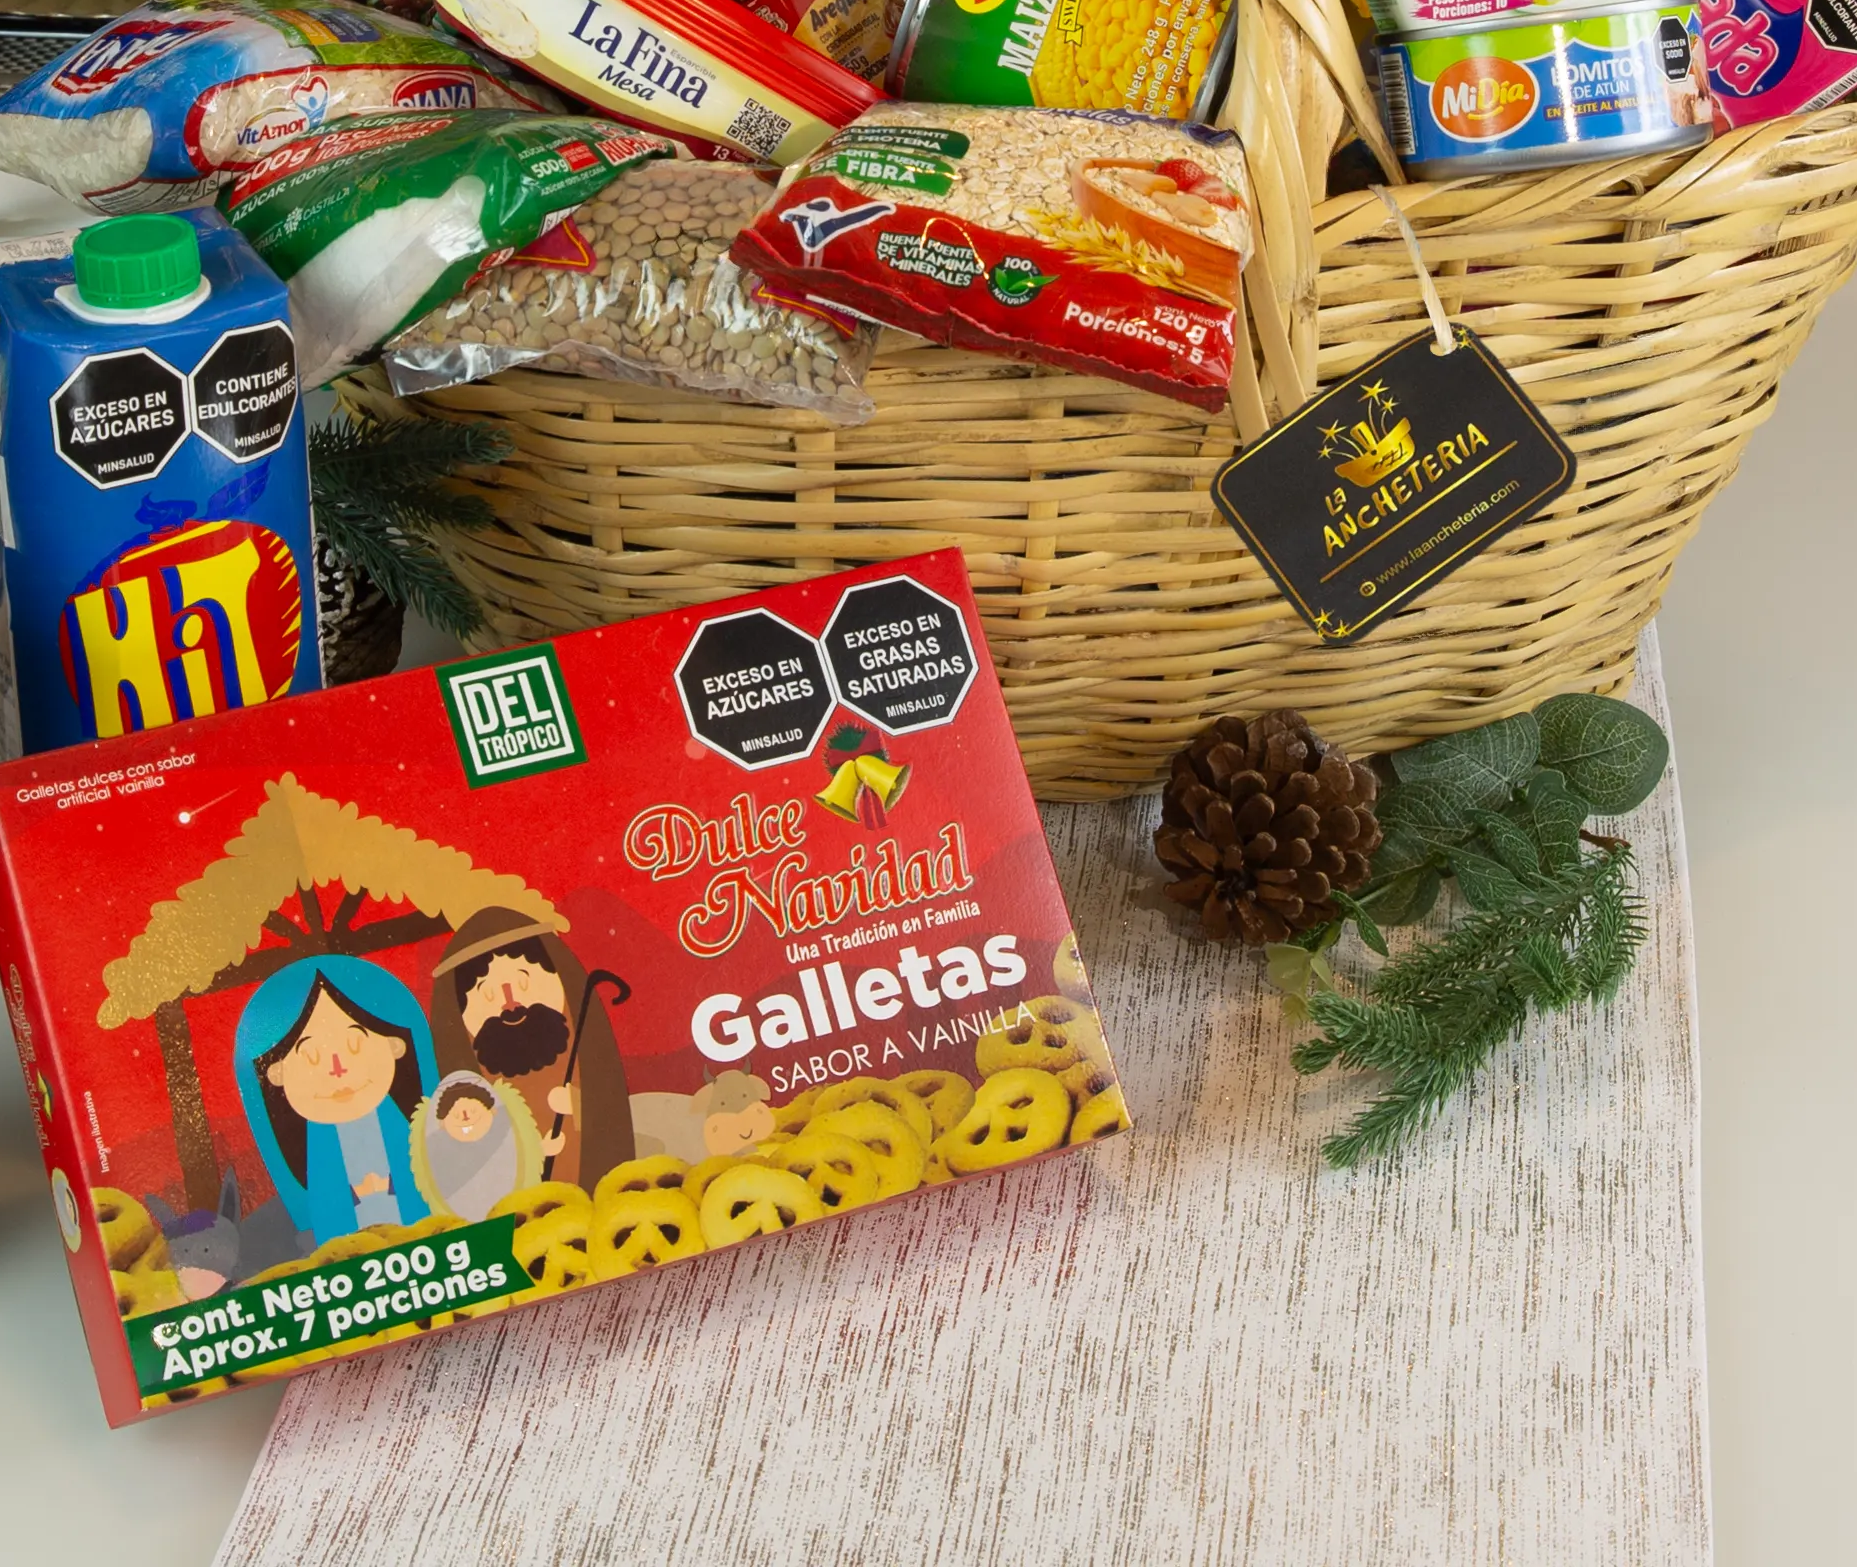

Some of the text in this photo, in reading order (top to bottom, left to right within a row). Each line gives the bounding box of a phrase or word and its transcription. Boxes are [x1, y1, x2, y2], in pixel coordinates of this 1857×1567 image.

[1432, 1, 1492, 19] Porciones:
[598, 64, 658, 101] Mesa
[620, 27, 709, 109] Fina
[669, 49, 717, 81] Esparcible
[1574, 80, 1630, 99] DE ATÚN
[877, 244, 984, 273] DE VITAMINAS
[880, 233, 974, 259] BUENA FUENTE
[1064, 301, 1205, 366] Porciones: 5
[1154, 307, 1207, 345] 120 g
[215, 362, 289, 395] CONTIENE
[73, 391, 167, 423] EXCESO EN
[198, 376, 296, 421] EDULCORANTES
[70, 408, 175, 445] AZÚCARES
[234, 423, 282, 449] MINSALUD
[97, 452, 155, 475] MINSALUD
[1323, 423, 1490, 558] ANCHETERIA
[1376, 479, 1521, 585] www.laancheteria.com
[844, 613, 942, 650] EXCESO EN
[859, 636, 941, 671] GRASAS
[702, 657, 803, 695] EXCESO EN
[847, 655, 966, 698] SATURADAS
[463, 672, 553, 735] DEL
[706, 678, 814, 721] AZÚCARES
[886, 694, 946, 718] MINSALUD
[479, 722, 561, 762] TRÓPICO
[741, 728, 803, 753] MINSALUD
[16, 752, 197, 803] Galletas dulces con sabor
[57, 774, 165, 809] artificial vainilla
[624, 793, 806, 882] Dulce
[679, 822, 974, 959] Navidad
[786, 900, 981, 965] Una Tradición en Familia
[691, 933, 1027, 1063] Galletas
[771, 1000, 1038, 1093] SABOR A VAINILLA
[153, 1239, 471, 1348] Cont. Neto 200 g
[162, 1261, 507, 1381] Aprox. 7 porciones
